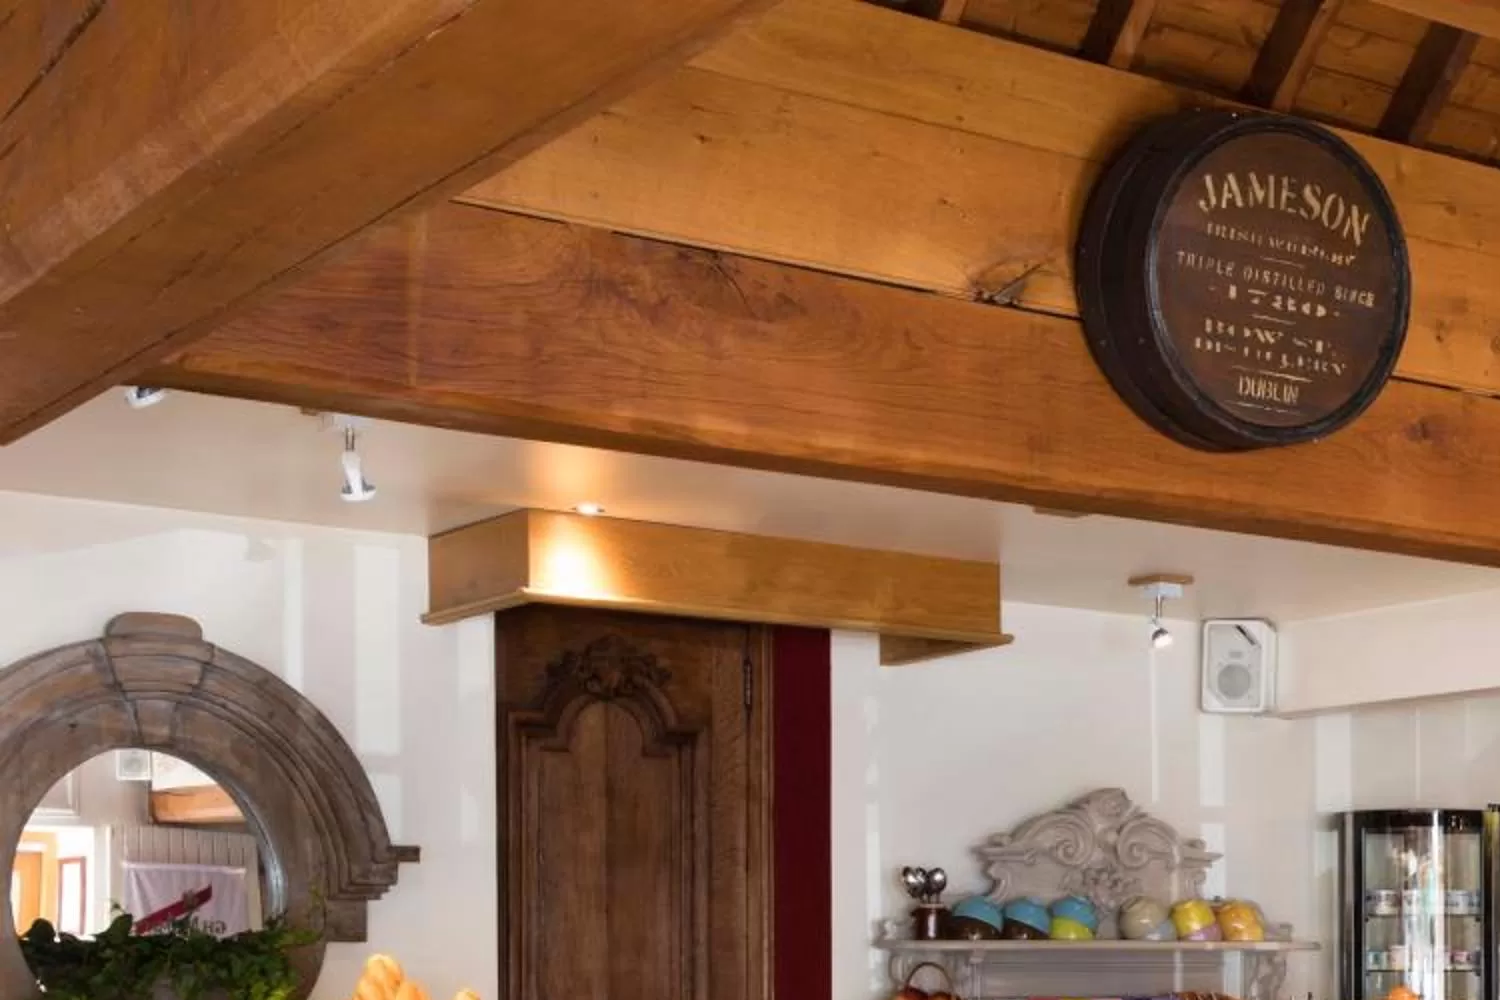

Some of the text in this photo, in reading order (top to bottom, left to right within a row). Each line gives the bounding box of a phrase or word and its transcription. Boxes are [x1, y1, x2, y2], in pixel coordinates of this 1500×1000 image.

[1200, 171, 1370, 247] JAMESON
[1177, 250, 1236, 278] TRIPLE
[1243, 266, 1326, 297] DISTILLED
[1238, 374, 1299, 404] DUBLIN
